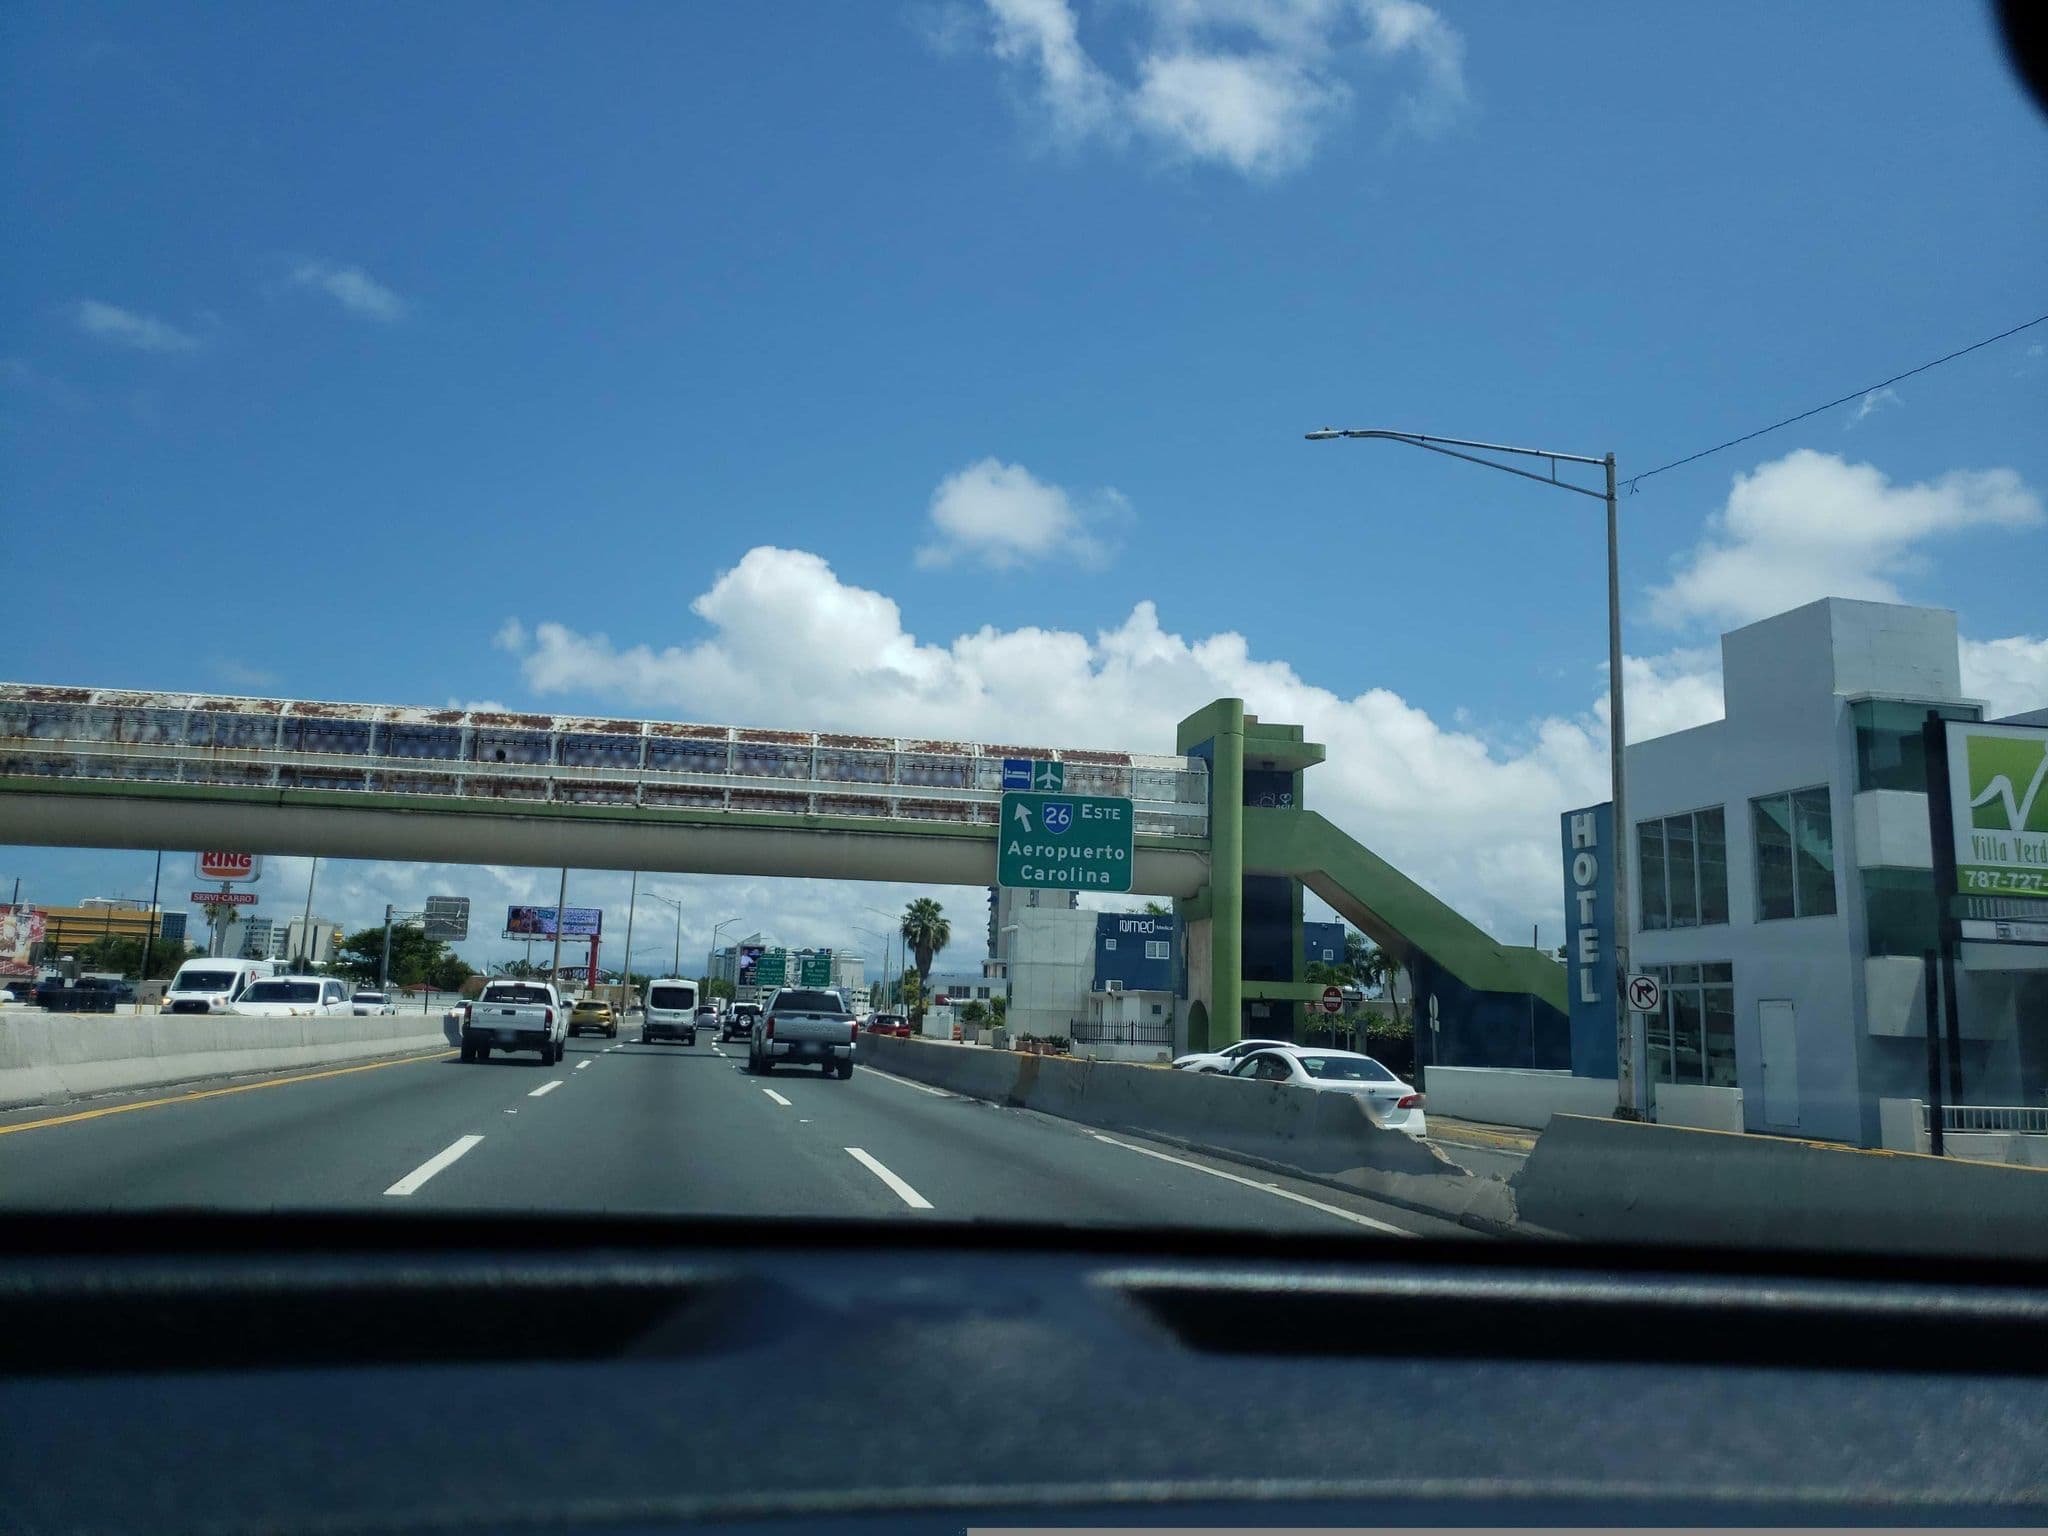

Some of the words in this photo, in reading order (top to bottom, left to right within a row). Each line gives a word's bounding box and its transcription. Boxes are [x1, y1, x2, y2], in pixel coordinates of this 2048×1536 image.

[1044, 806, 1070, 825] 26
[1007, 840, 1125, 862] Aeropuerto
[1971, 835, 2007, 862] Villa
[202, 850, 252, 867] KING
[1020, 864, 1110, 883] Carolina
[193, 893, 253, 903] SERVI-CARRO
[1570, 812, 1601, 1003] HOTEL
